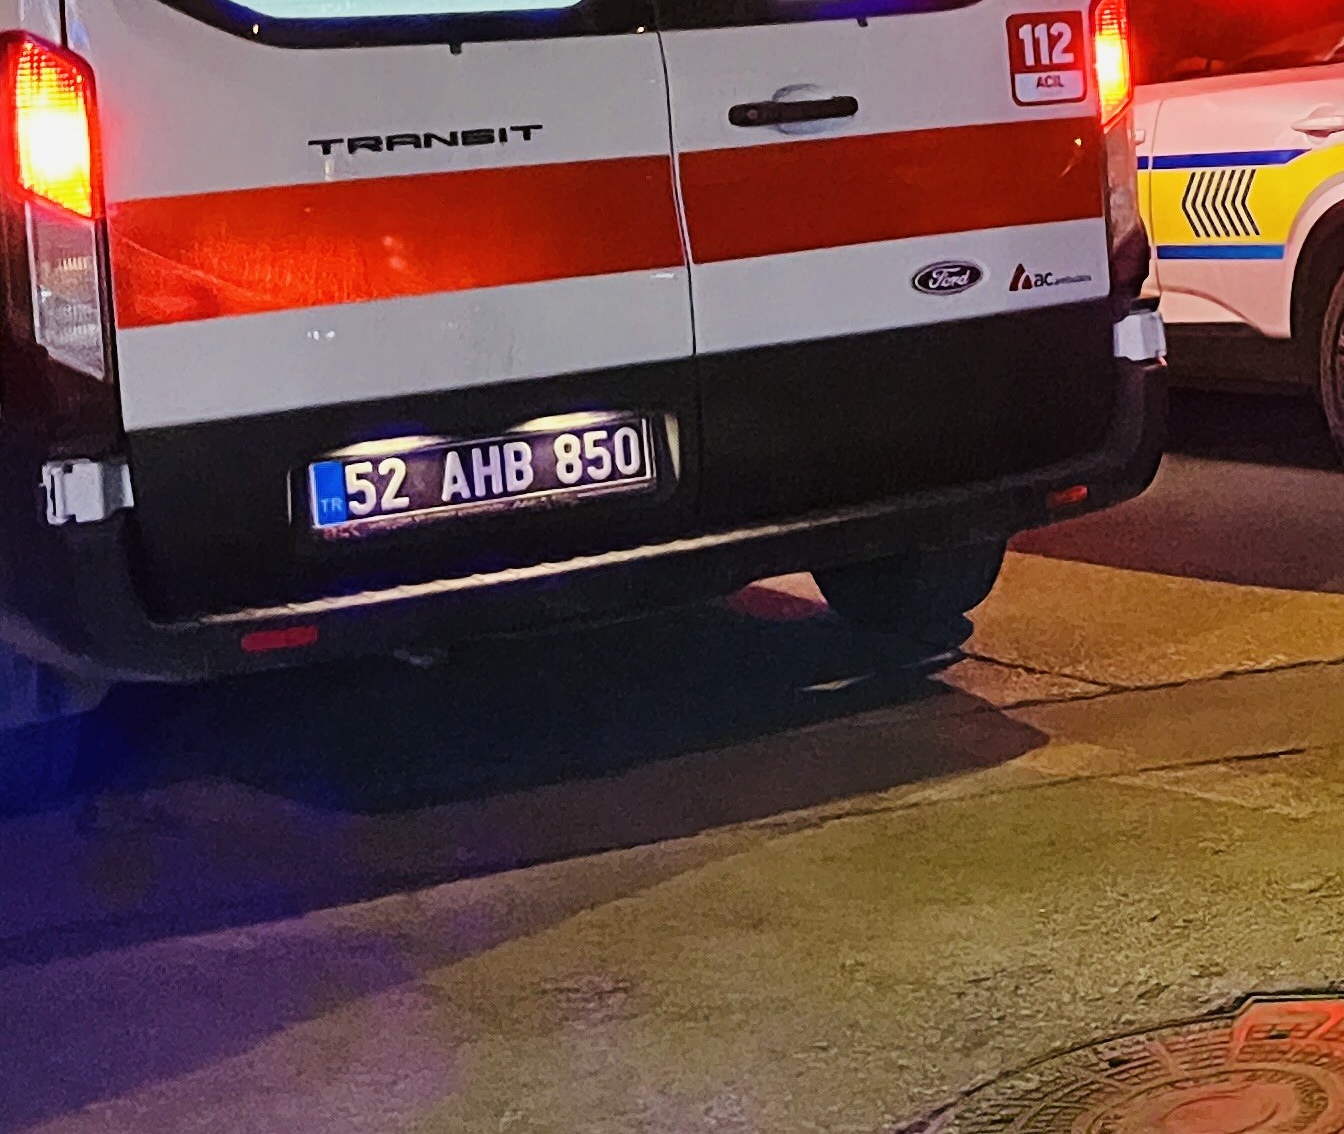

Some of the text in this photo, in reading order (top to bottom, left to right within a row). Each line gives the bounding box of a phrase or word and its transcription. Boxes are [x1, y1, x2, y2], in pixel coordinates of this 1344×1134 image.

[1018, 22, 1075, 66] 112
[308, 123, 543, 155] TRANSIT
[928, 267, 971, 289] Ford
[346, 426, 641, 515] 52 AHB 850
[319, 495, 343, 514] TR
